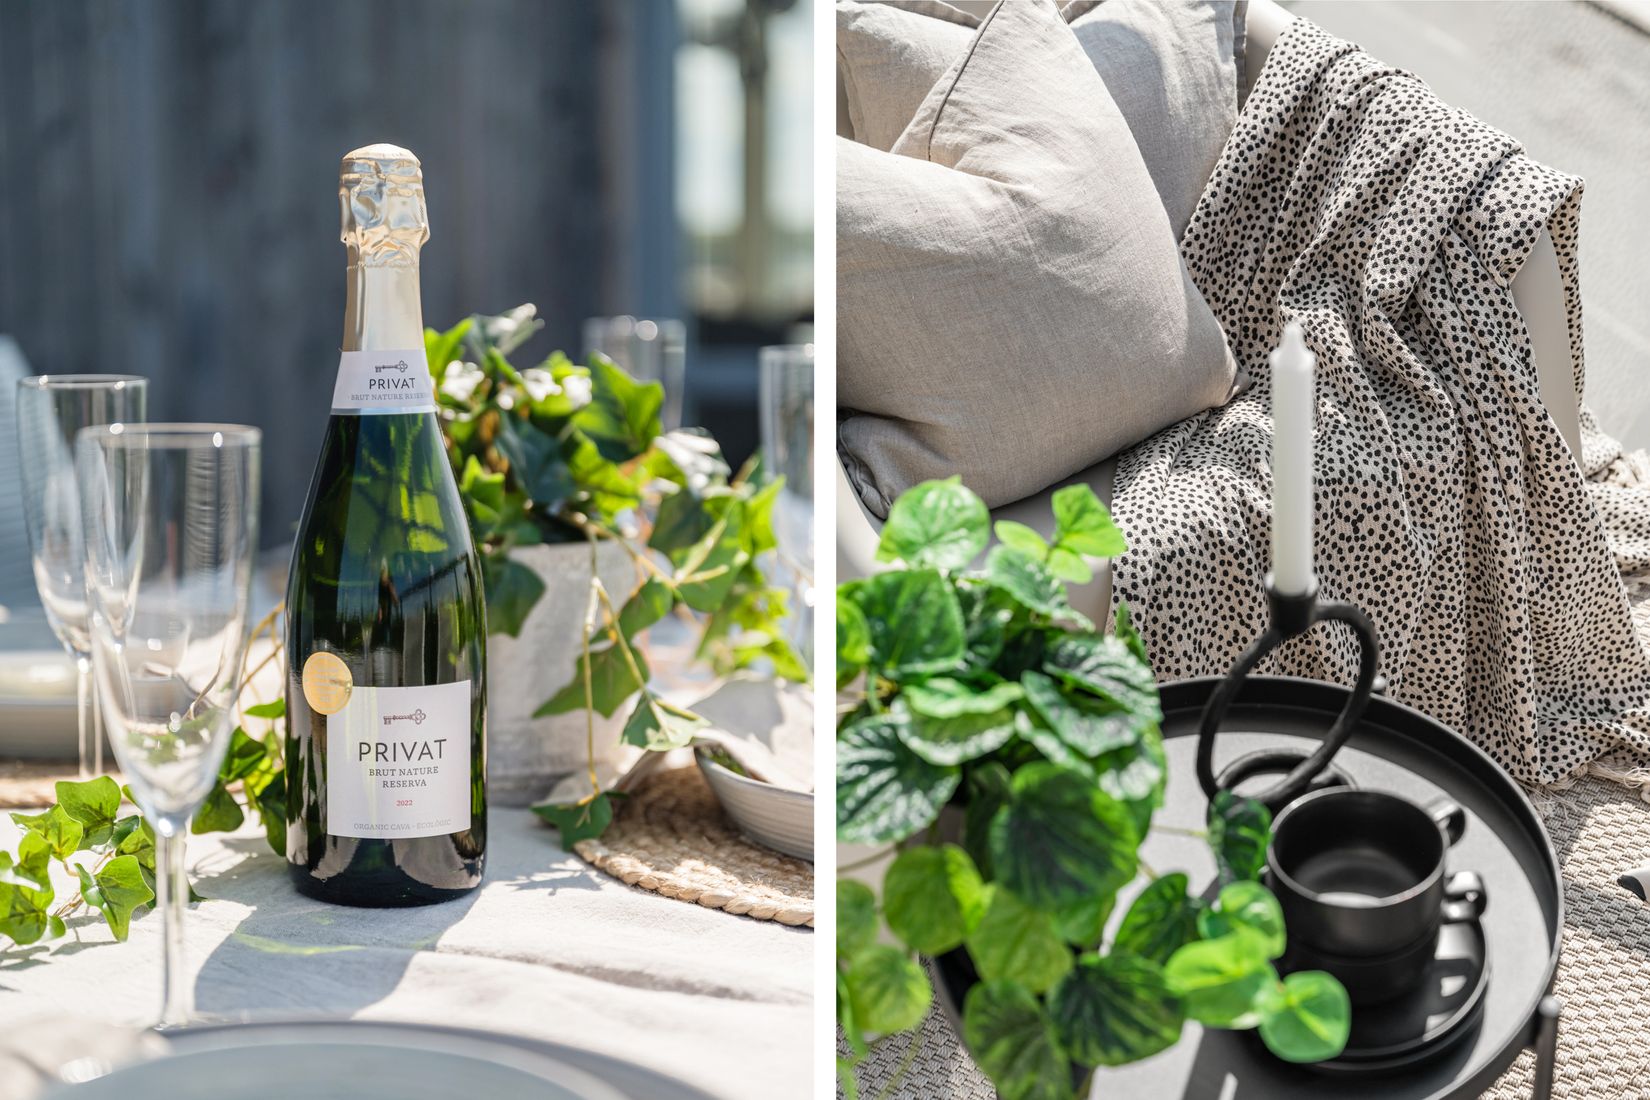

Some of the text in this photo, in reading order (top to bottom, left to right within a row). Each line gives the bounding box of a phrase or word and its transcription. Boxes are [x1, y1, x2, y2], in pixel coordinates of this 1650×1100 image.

[369, 377, 416, 390] PRIVAT
[371, 393, 403, 401] NATURE
[358, 738, 447, 762] PRIVAT
[368, 766, 439, 777] BRUT NATURE
[382, 779, 427, 788] RESERVA
[395, 799, 413, 807] 2022
[353, 822, 389, 831] ORGANIC
[390, 823, 411, 831] CAVA
